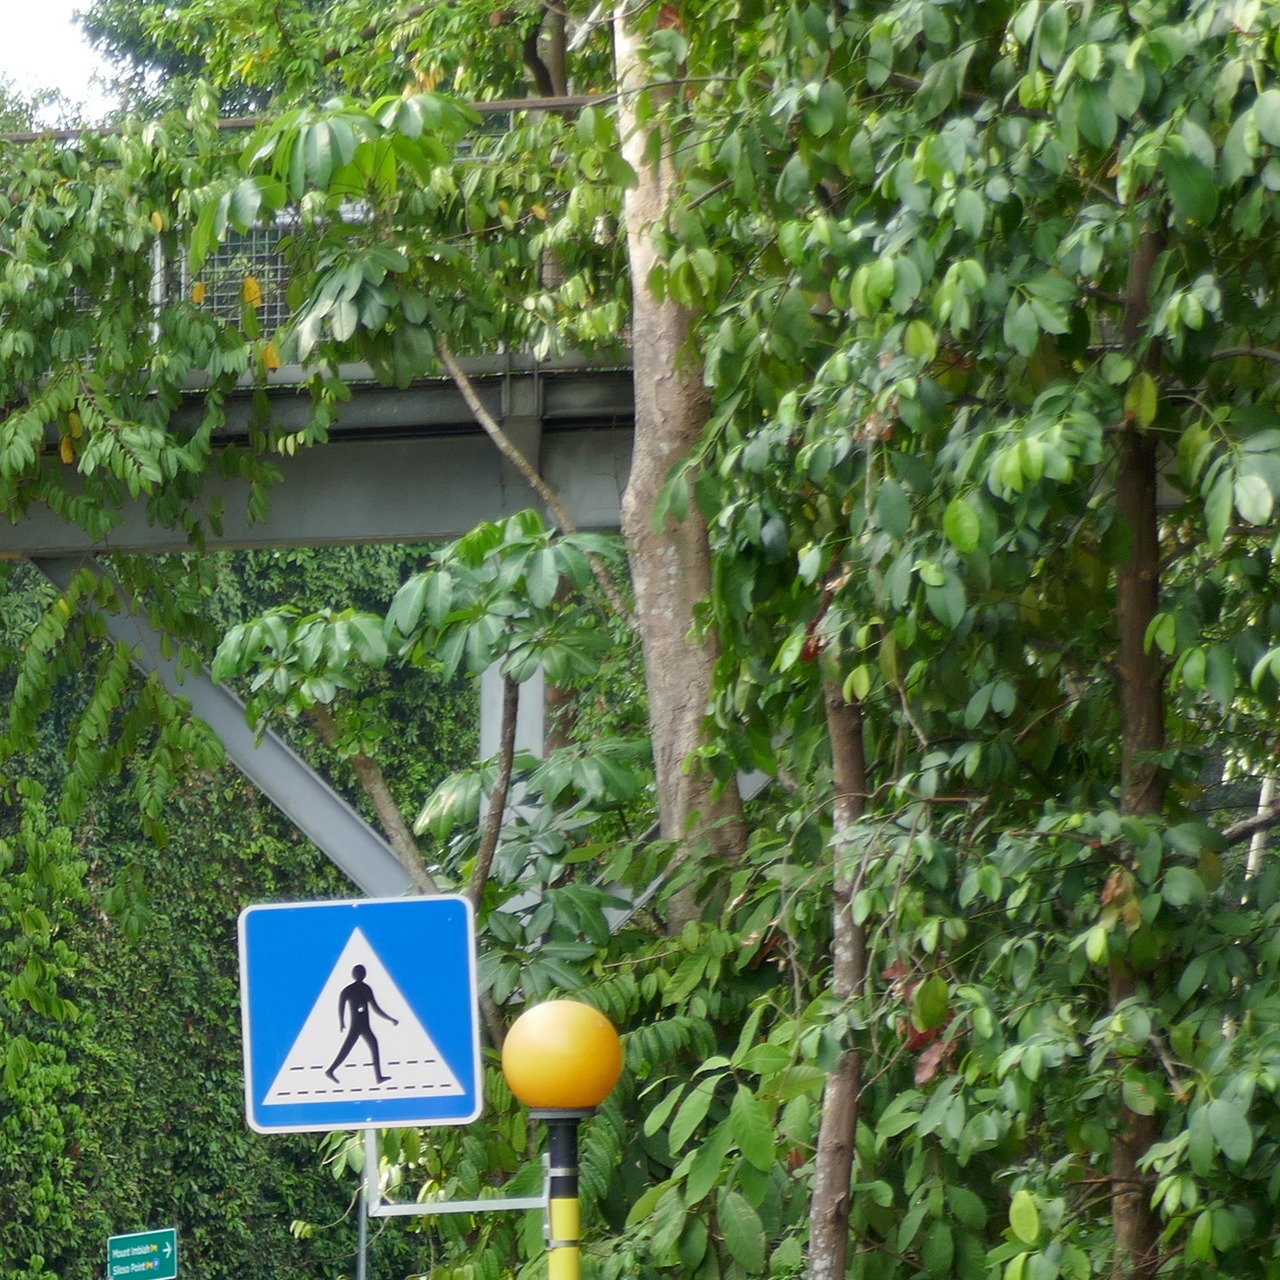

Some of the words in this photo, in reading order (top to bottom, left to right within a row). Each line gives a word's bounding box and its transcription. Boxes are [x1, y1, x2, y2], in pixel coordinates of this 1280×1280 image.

[112, 1247, 130, 1259] Mount
[112, 1265, 130, 1276] Siloso
[130, 1261, 146, 1273] Point
